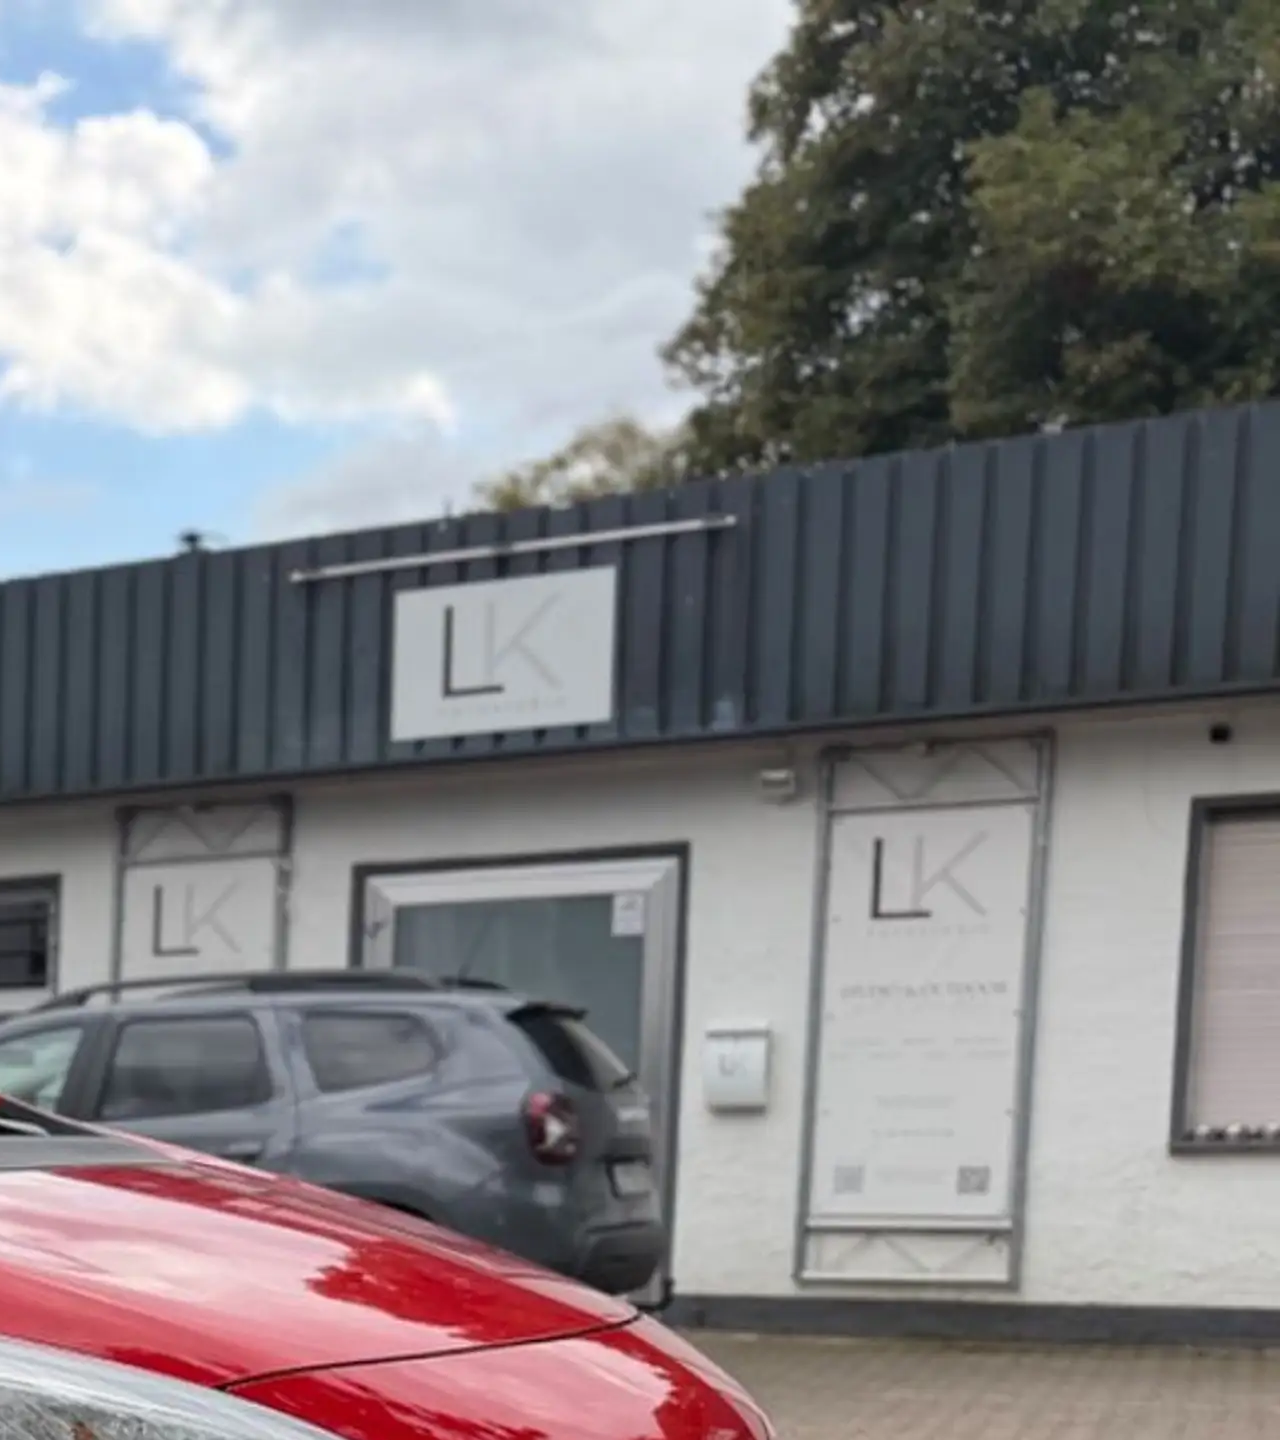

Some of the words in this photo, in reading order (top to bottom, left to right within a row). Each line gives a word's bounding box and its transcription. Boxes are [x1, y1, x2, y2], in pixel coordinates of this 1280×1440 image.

[443, 589, 563, 697] LK
[153, 876, 242, 957] LK
[869, 829, 990, 920] LK
